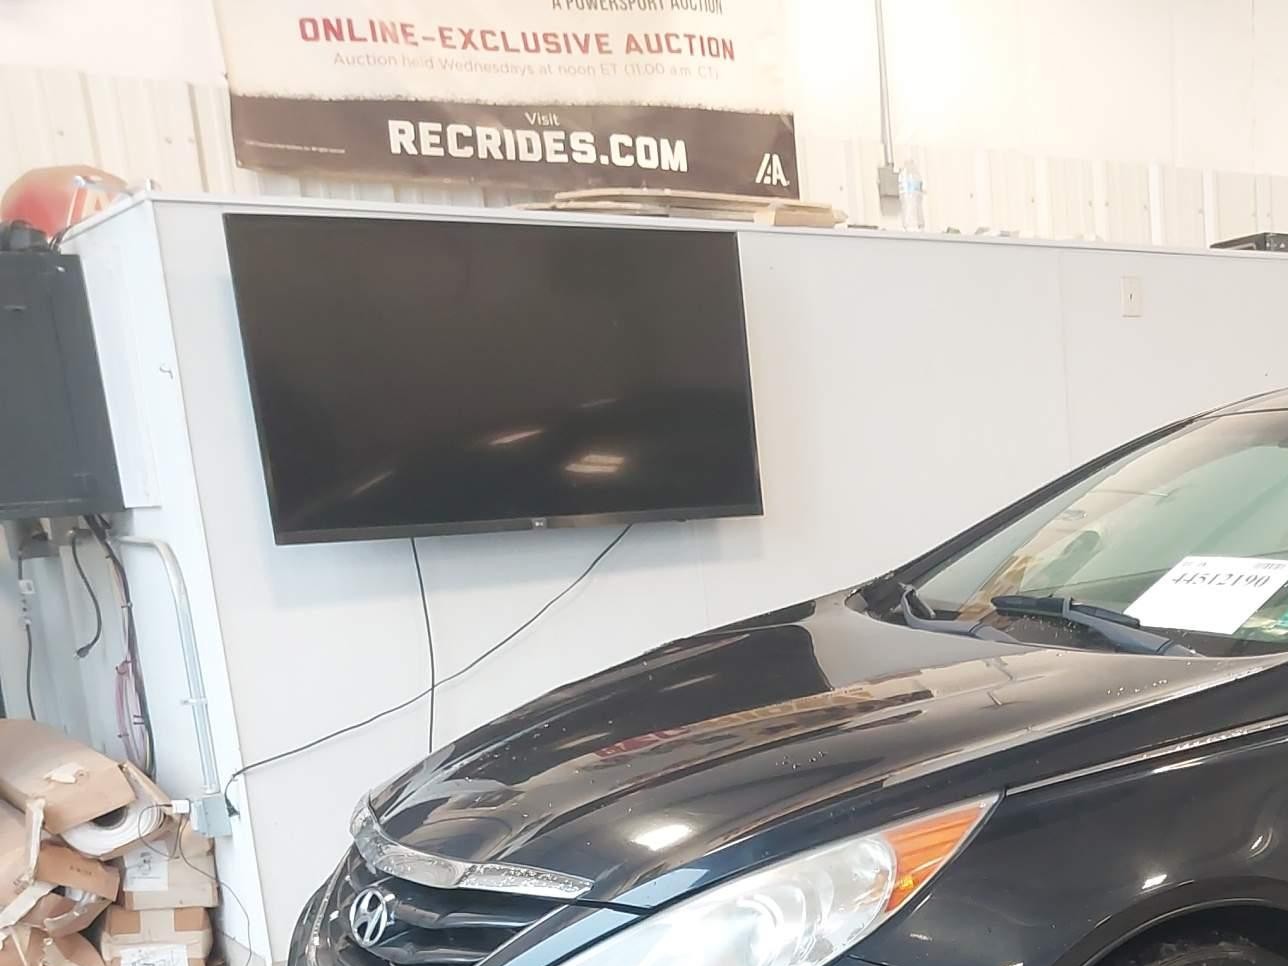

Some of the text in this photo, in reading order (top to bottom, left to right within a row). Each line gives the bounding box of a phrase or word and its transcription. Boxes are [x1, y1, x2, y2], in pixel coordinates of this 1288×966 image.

[299, 17, 735, 61] ONLINE-EXCLUSIVE AUCTION
[333, 52, 398, 67] Auction
[438, 58, 534, 77] Wednesdays
[558, 63, 596, 77] noon
[524, 112, 561, 127] Visit
[387, 119, 689, 173] RECRIDES.COM
[1172, 572, 1270, 587] 44512190
